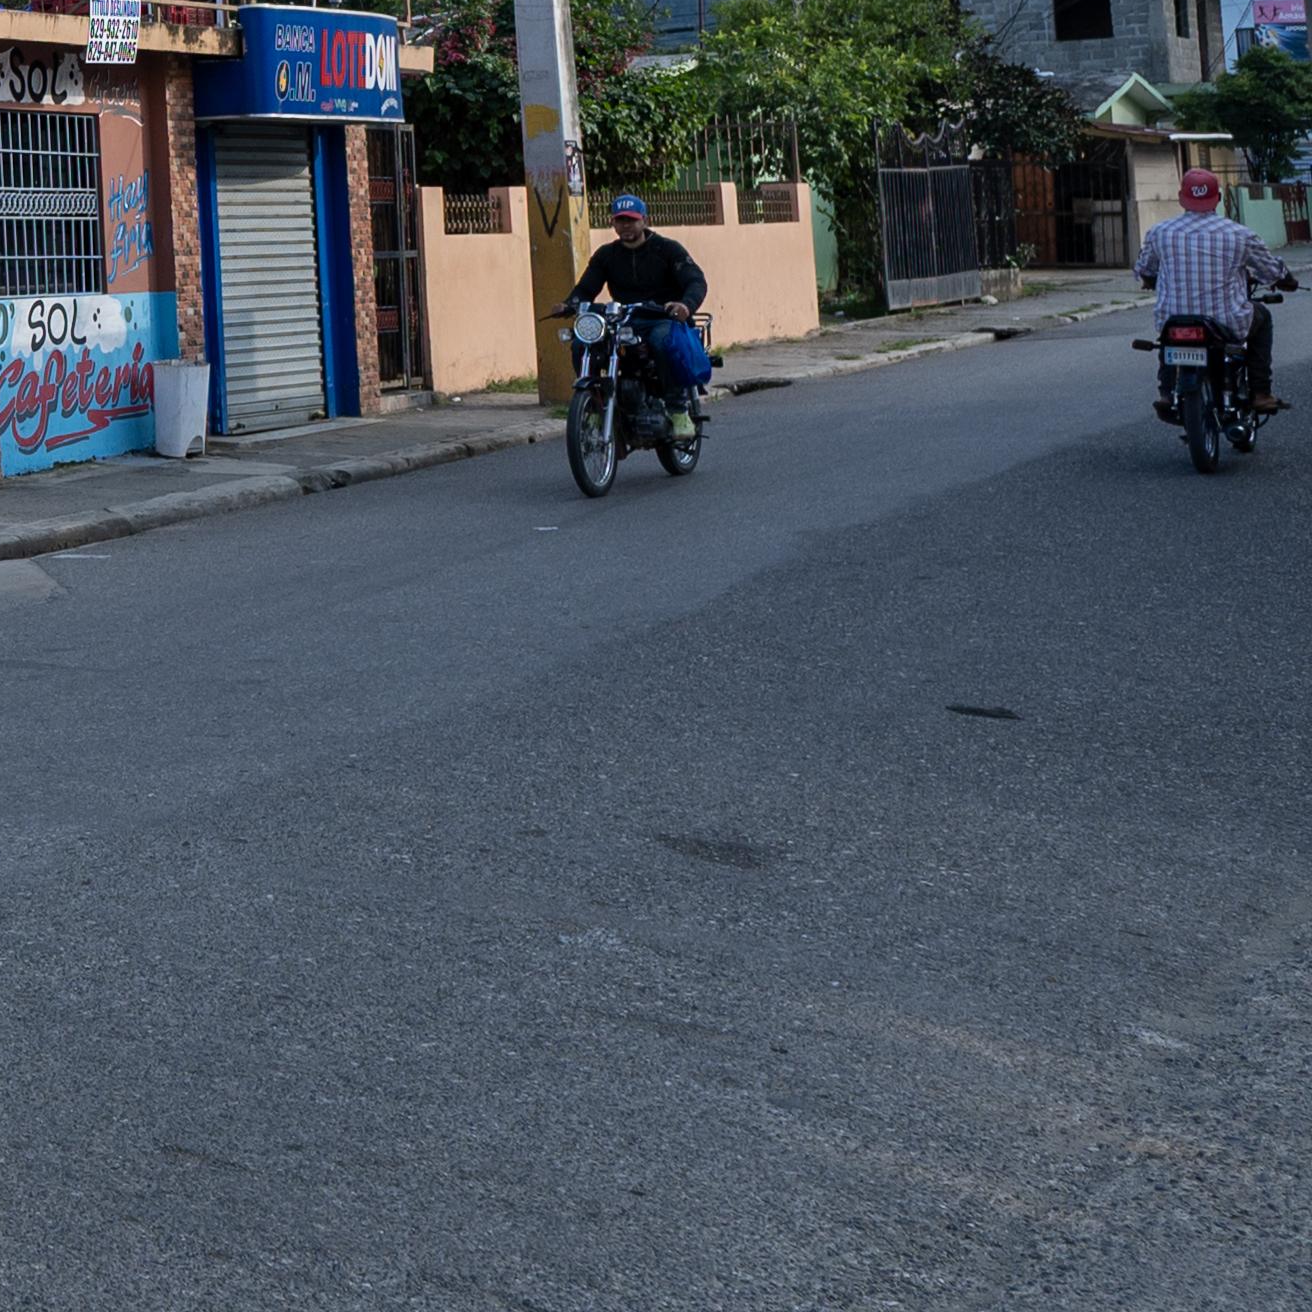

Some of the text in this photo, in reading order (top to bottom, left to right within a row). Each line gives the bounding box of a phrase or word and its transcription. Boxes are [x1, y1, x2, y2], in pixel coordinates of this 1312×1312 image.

[90, 18, 139, 39] 829-932-2610
[275, 24, 315, 53] BANCA
[320, 28, 396, 91] LOTEDOM
[616, 200, 634, 209] VIP
[28, 298, 87, 352] SOL
